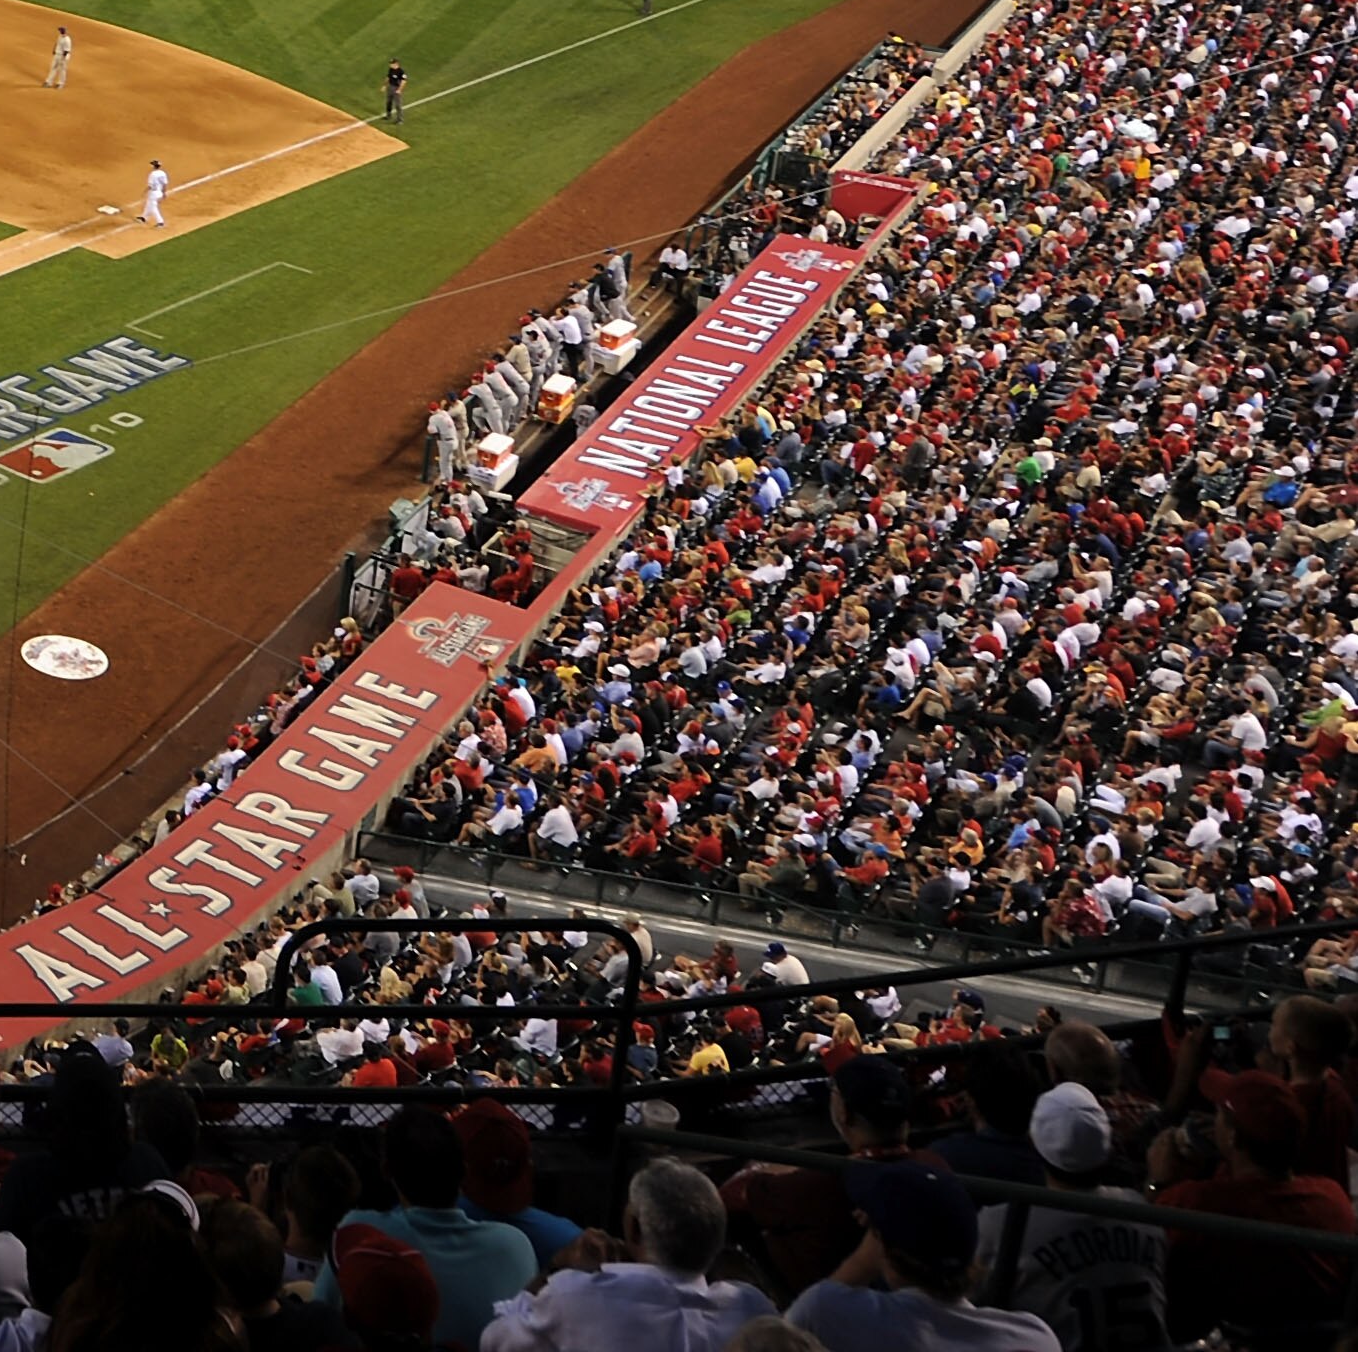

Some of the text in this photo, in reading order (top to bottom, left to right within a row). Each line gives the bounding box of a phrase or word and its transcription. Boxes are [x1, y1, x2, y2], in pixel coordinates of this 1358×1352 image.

[577, 268, 821, 480] NATIONAL LEAGUE
[277, 670, 443, 794] GAME
[1034, 1225, 1156, 1281] PEDROIA
